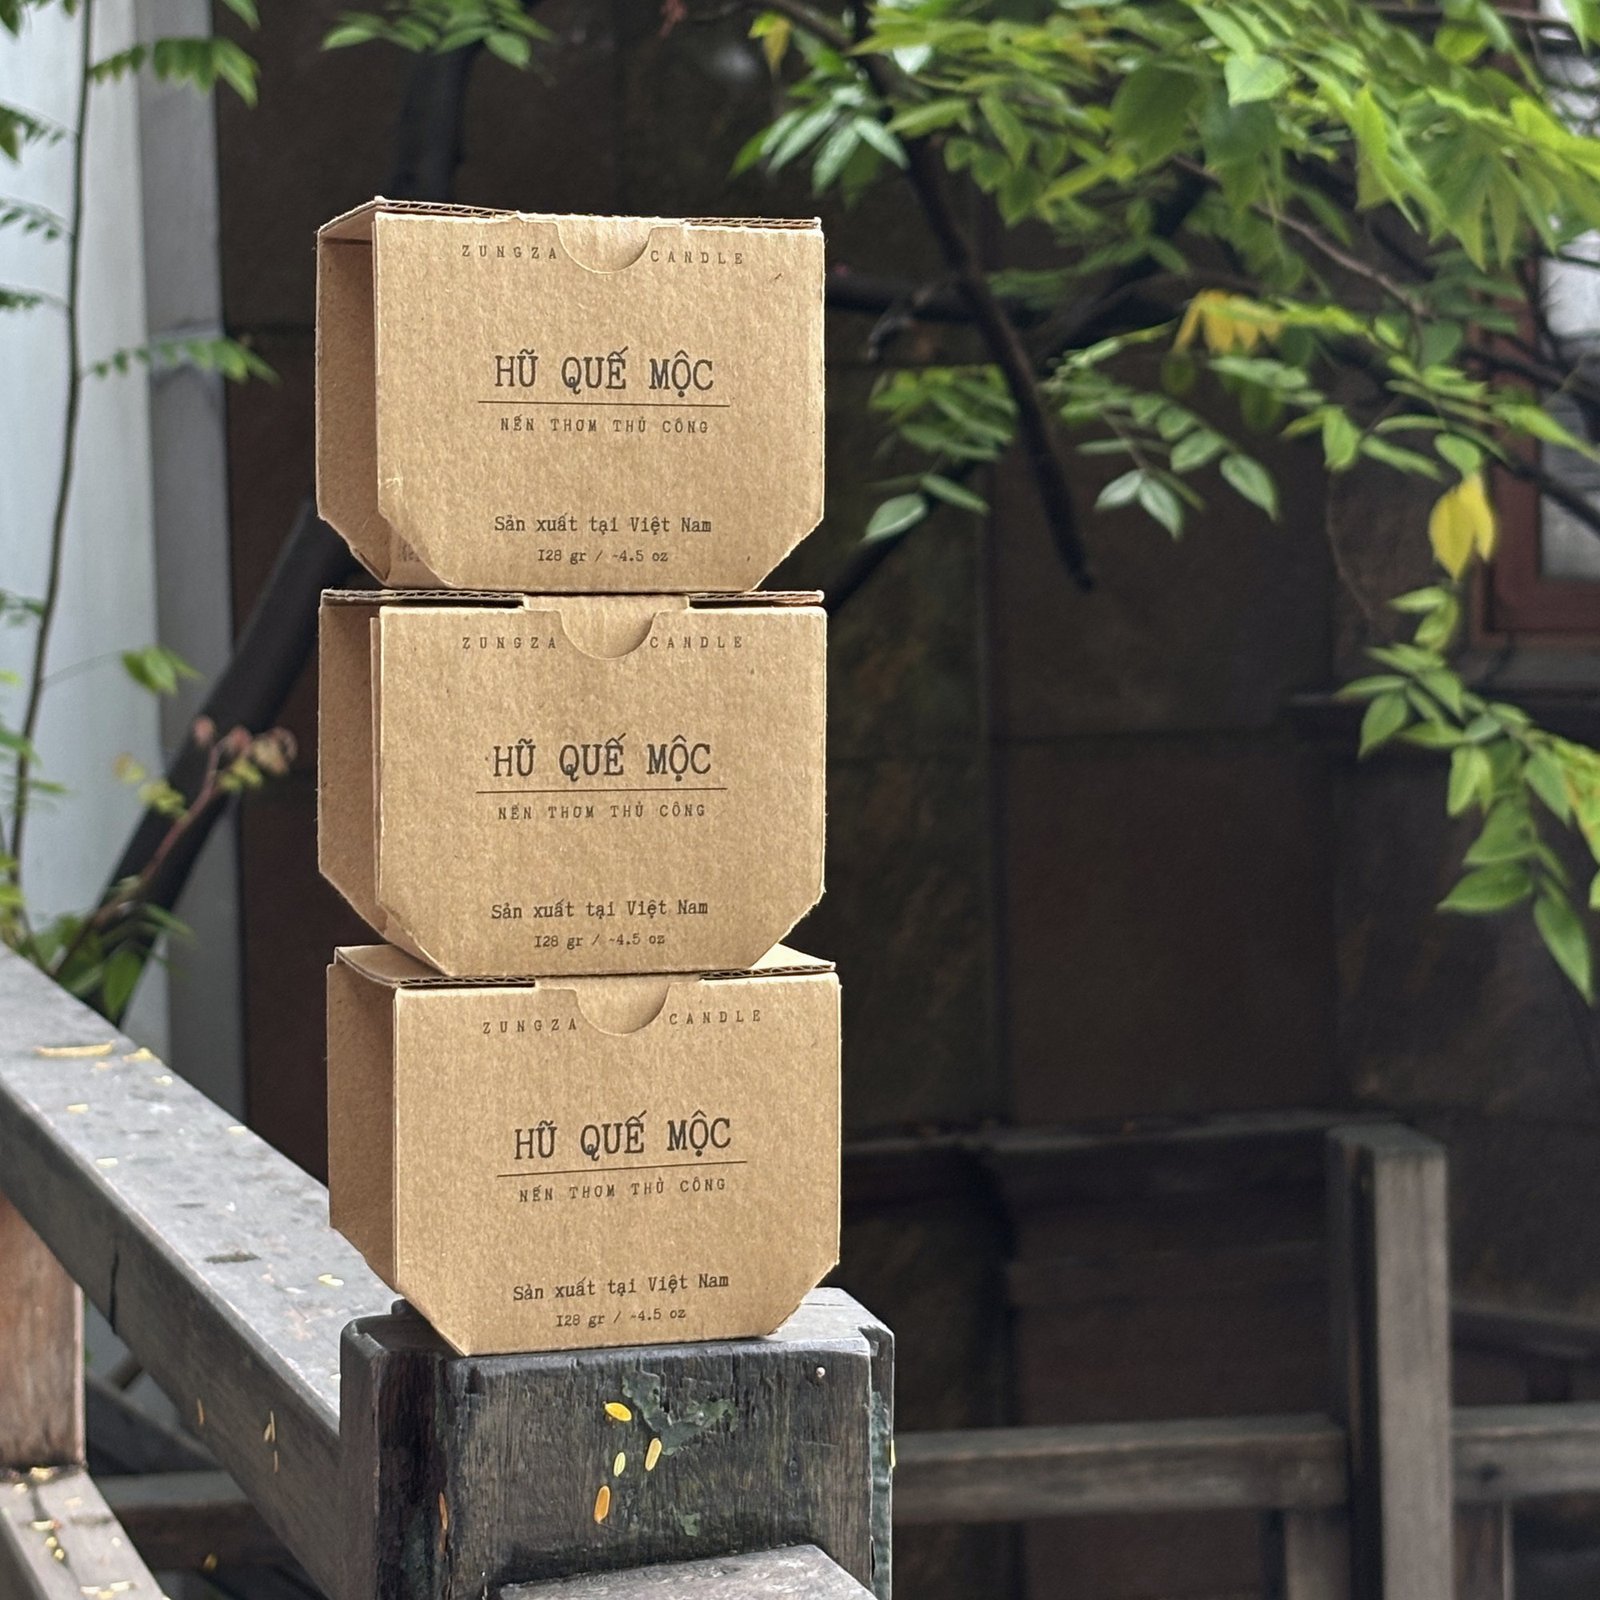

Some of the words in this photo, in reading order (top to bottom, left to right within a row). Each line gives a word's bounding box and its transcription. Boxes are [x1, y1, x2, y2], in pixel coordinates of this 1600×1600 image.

[462, 245, 557, 259] ZUNGZA
[651, 250, 743, 264] CANDLE
[495, 348, 539, 387] HŨ
[561, 346, 628, 395] QUẾ
[649, 350, 713, 398] MỘC
[500, 415, 534, 432] NẾN
[613, 416, 646, 432] THỦ
[662, 418, 709, 433] CÔNG
[495, 514, 525, 532] Sản
[536, 512, 577, 532] xuất
[589, 516, 618, 536] tại
[630, 516, 670, 535] Việt
[681, 517, 712, 532] Nam
[538, 550, 561, 562] 128
[570, 551, 586, 565] gr
[652, 552, 668, 562] oz
[462, 637, 556, 649] ZUNGZA
[650, 636, 742, 649] CANDLE
[493, 738, 536, 777] HŨ
[559, 732, 626, 782] QUẾ
[646, 734, 711, 782] MỘC
[499, 802, 531, 820] NẾN
[610, 801, 643, 817] THỦ
[659, 803, 706, 817] CÔNG
[491, 902, 522, 919] Sản
[533, 899, 574, 917] xuất
[586, 901, 615, 920] tại
[627, 899, 667, 918] Việt
[677, 899, 708, 915] Nam
[534, 935, 558, 948] 128
[567, 935, 583, 949] gr
[649, 934, 665, 945] oz
[483, 1018, 577, 1034] ZUNGZA
[669, 1010, 761, 1025] CANDLE
[514, 1120, 557, 1160] HŨ
[580, 1110, 647, 1161] QUẾ
[667, 1109, 731, 1157] MỘC
[519, 1184, 553, 1202] NẾN
[631, 1177, 664, 1195] THỦ
[680, 1177, 726, 1192] CÔNG
[513, 1285, 543, 1301] Sản
[555, 1276, 595, 1298] xuất
[608, 1278, 636, 1297] tại
[649, 1274, 688, 1294] Việt
[698, 1273, 729, 1288] Nam
[556, 1314, 580, 1327] 128
[588, 1315, 605, 1328] gr
[670, 1309, 686, 1319] oz
